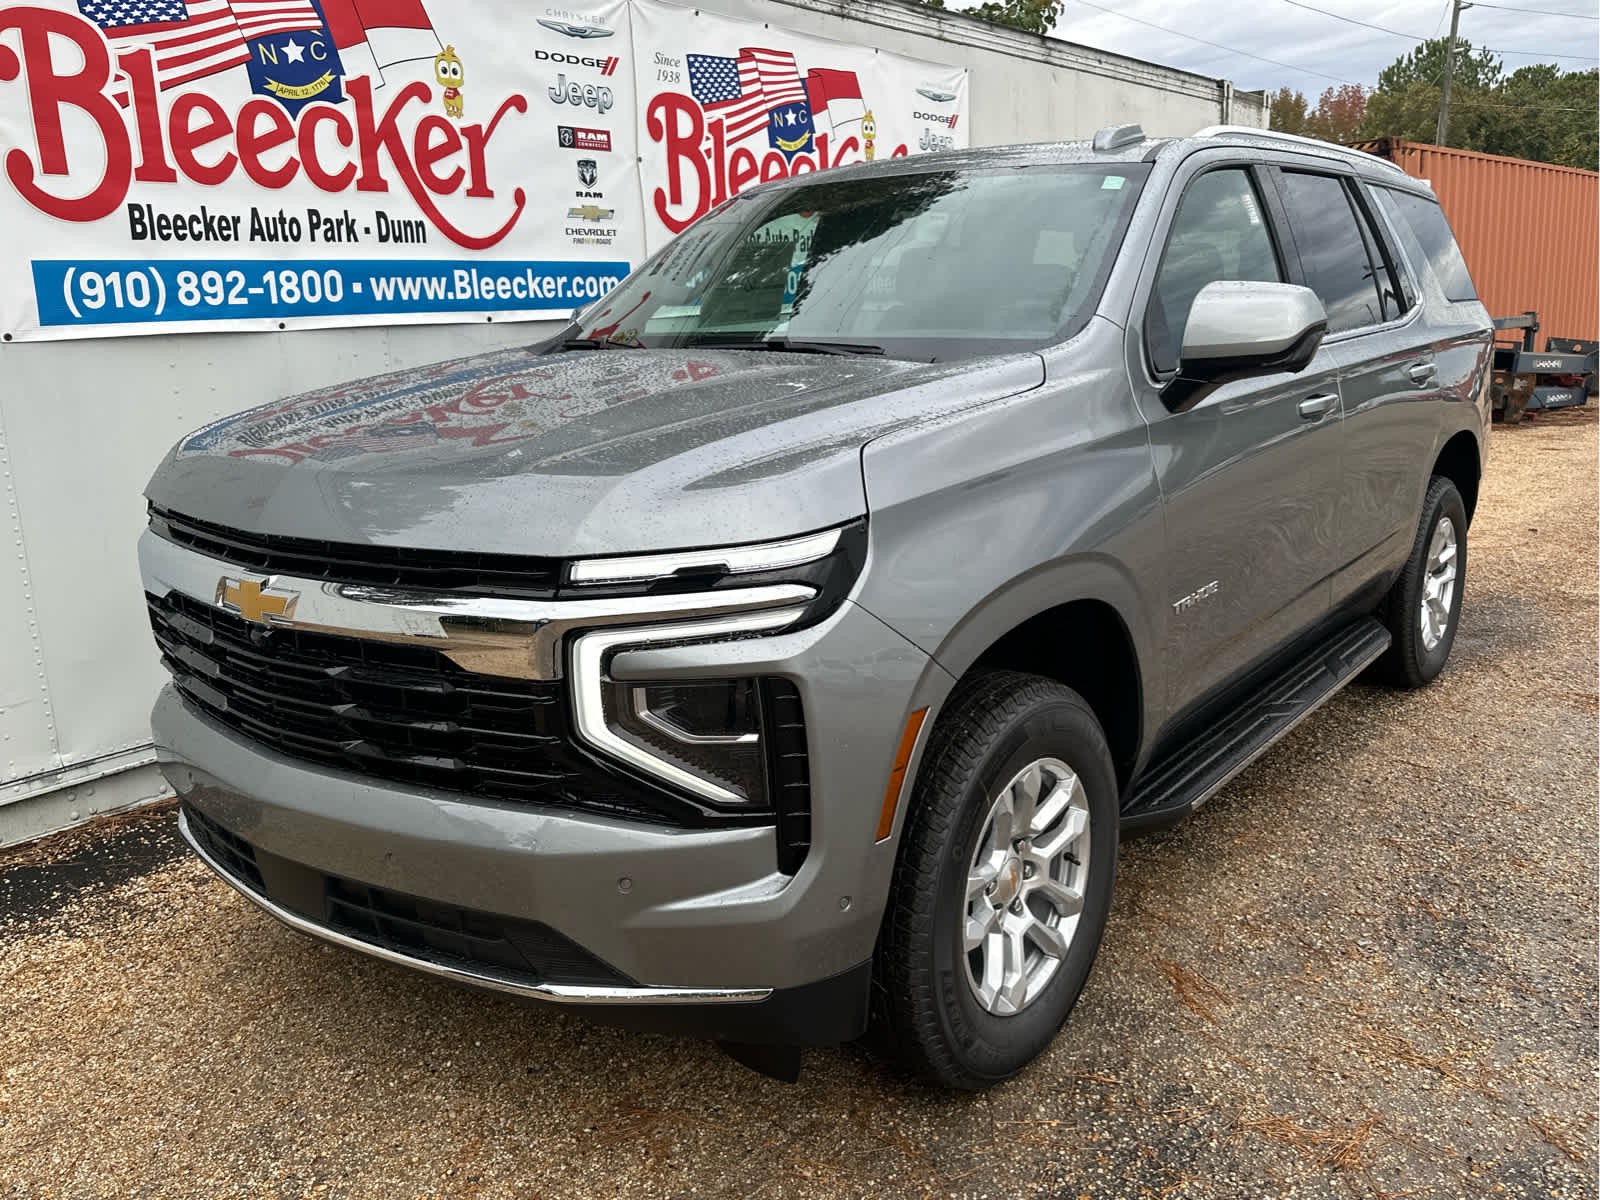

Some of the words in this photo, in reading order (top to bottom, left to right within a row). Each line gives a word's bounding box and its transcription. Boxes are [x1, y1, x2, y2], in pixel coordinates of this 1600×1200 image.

[545, 8, 606, 25] CHRYSLER
[257, 43, 279, 65] N
[310, 41, 327, 61] C
[535, 50, 609, 69] DODGE
[654, 51, 681, 68] Since
[656, 68, 681, 84] 1938
[277, 86, 300, 97] APRIL
[311, 79, 327, 92] 1776
[548, 73, 614, 115] Jeep
[773, 112, 784, 128] N
[798, 110, 808, 124] C
[913, 111, 953, 124] DODGE
[0, 7, 528, 250] Bleecker
[577, 131, 608, 142] RAM
[575, 190, 604, 199] RAM
[127, 203, 241, 242] Bleecker
[249, 207, 301, 243] Auto
[306, 208, 360, 244] Park
[375, 210, 428, 245] Dunn
[565, 227, 617, 237] CHEVROLET
[63, 266, 167, 316] (910)
[176, 269, 344, 307] 892-1800
[369, 268, 620, 302] www.Bleecker.com
[1172, 580, 1219, 615] TAHOE
